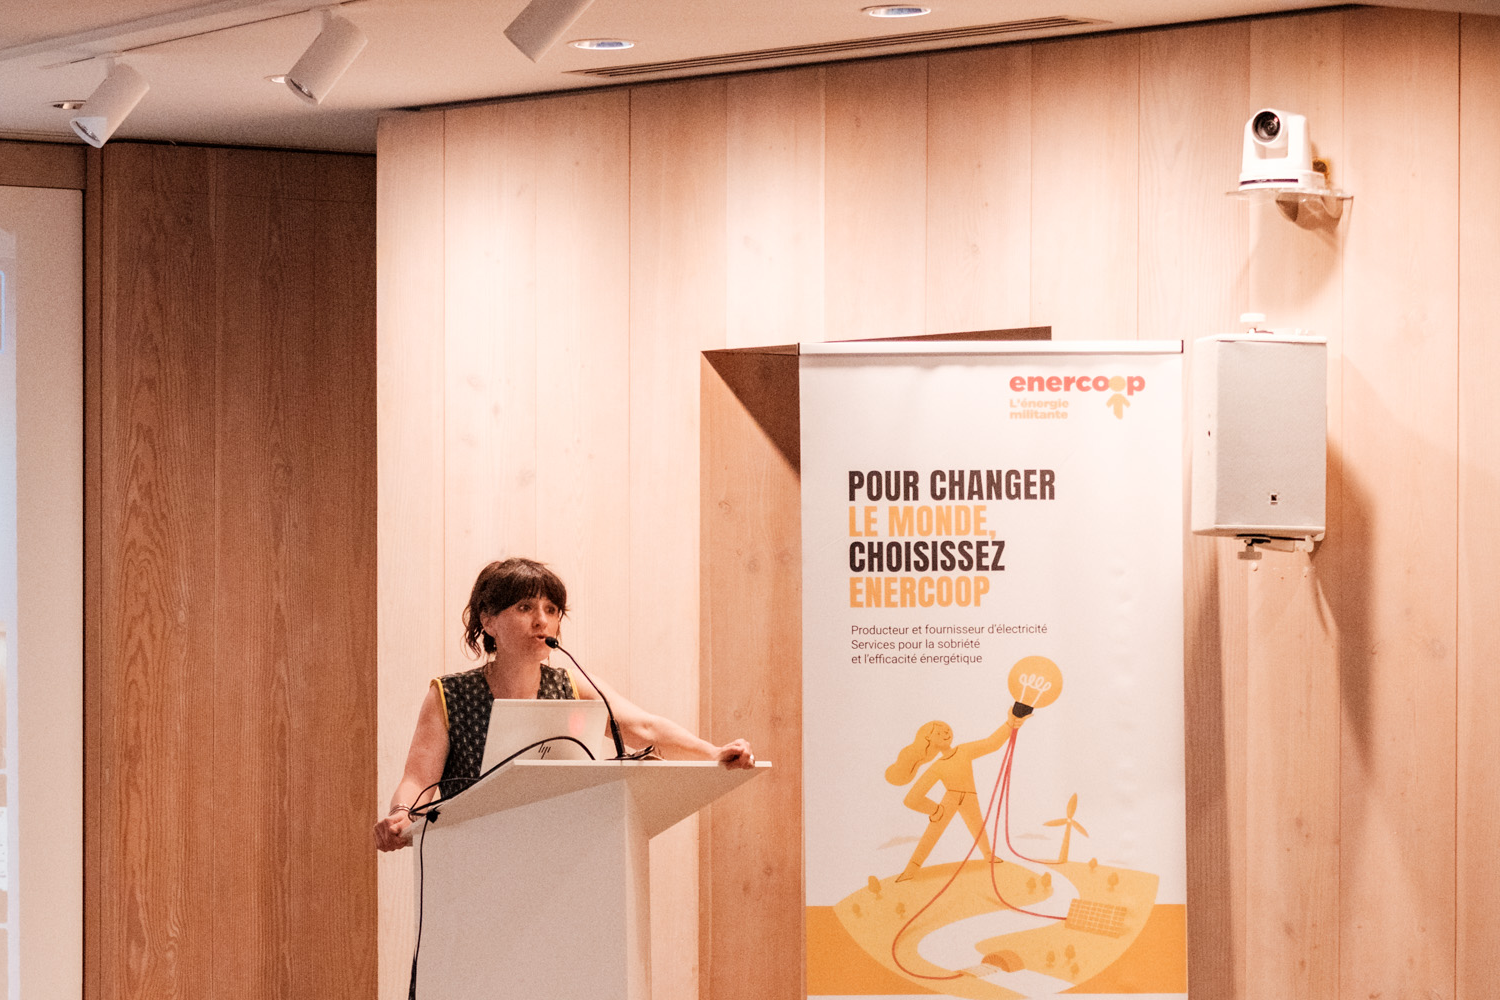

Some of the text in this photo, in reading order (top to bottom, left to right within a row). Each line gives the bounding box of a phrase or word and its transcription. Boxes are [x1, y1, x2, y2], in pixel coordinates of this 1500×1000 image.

[1010, 376, 1145, 396] enercoop
[1010, 398, 1069, 410] L'énergie
[1010, 410, 1068, 419] militante
[848, 469, 1056, 501] POUR CHANGER
[849, 505, 997, 540] LE MONDE,
[849, 541, 1005, 572] CHOISISSEZ
[849, 576, 990, 608] ENERCOOP
[851, 624, 1047, 635] Producteur et fournisseur d'électricité
[851, 639, 980, 651] Services pour la sobriété
[851, 654, 982, 665] et l'efficacité énergétique
